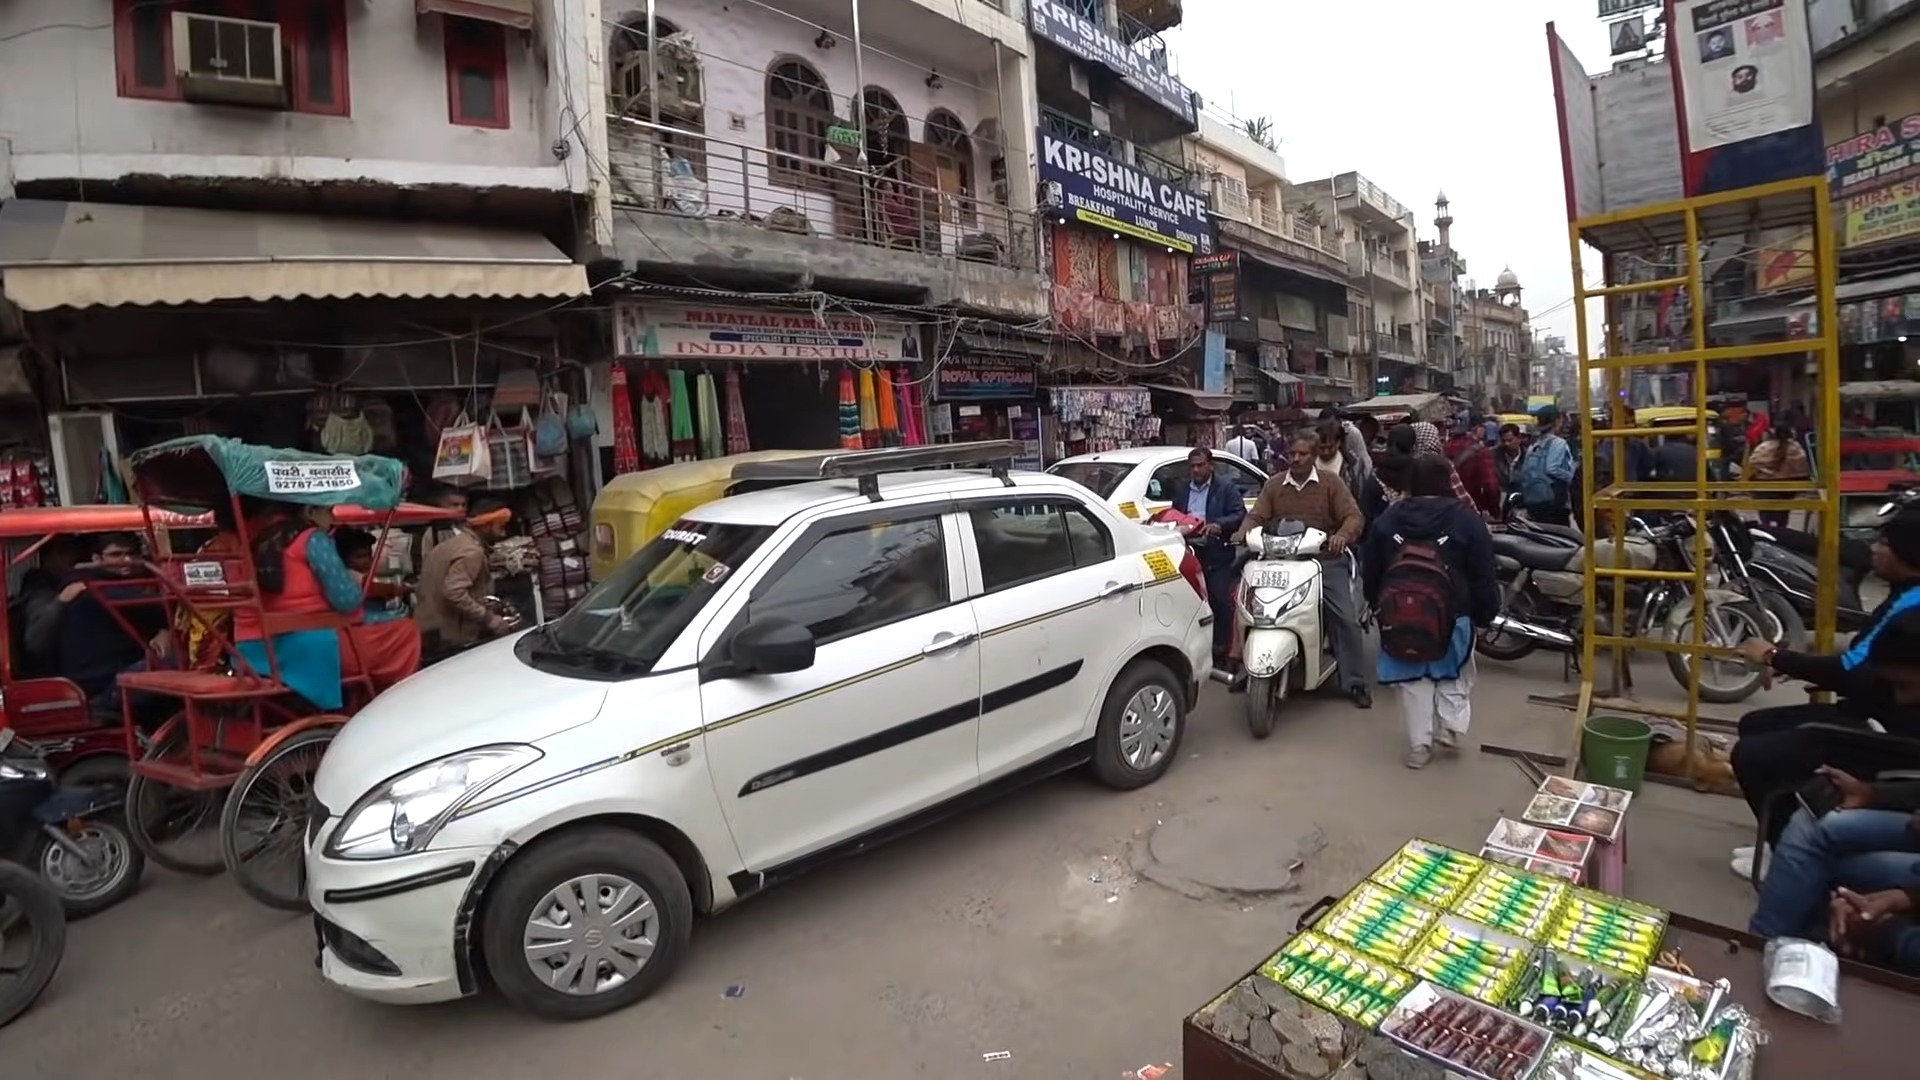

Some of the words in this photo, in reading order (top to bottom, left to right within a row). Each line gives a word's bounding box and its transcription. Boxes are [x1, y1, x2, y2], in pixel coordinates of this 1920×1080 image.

[1032, 0, 1142, 71] KRISHNA
[1146, 63, 1192, 104] CAFE
[1079, 37, 1133, 76] HOSPITALITY
[1135, 72, 1164, 95] SERVICE
[1826, 126, 1896, 167] HIRA
[1043, 135, 1155, 203] KRISHNA
[1159, 185, 1208, 223] CAFE
[1853, 186, 1896, 210] HIRA
[1068, 193, 1115, 218] BREAKFAST
[1135, 215, 1158, 232] LUNCH
[1176, 229, 1198, 245] DINNER
[1093, 184, 1148, 214] HOSPITALITY
[1149, 204, 1179, 225] SERVICE
[686, 310, 781, 327] MAFATLAL
[784, 317, 840, 331] FAMIY
[677, 342, 768, 356] INDIA
[941, 370, 980, 382] ROYAL
[662, 529, 707, 545] OURIST
